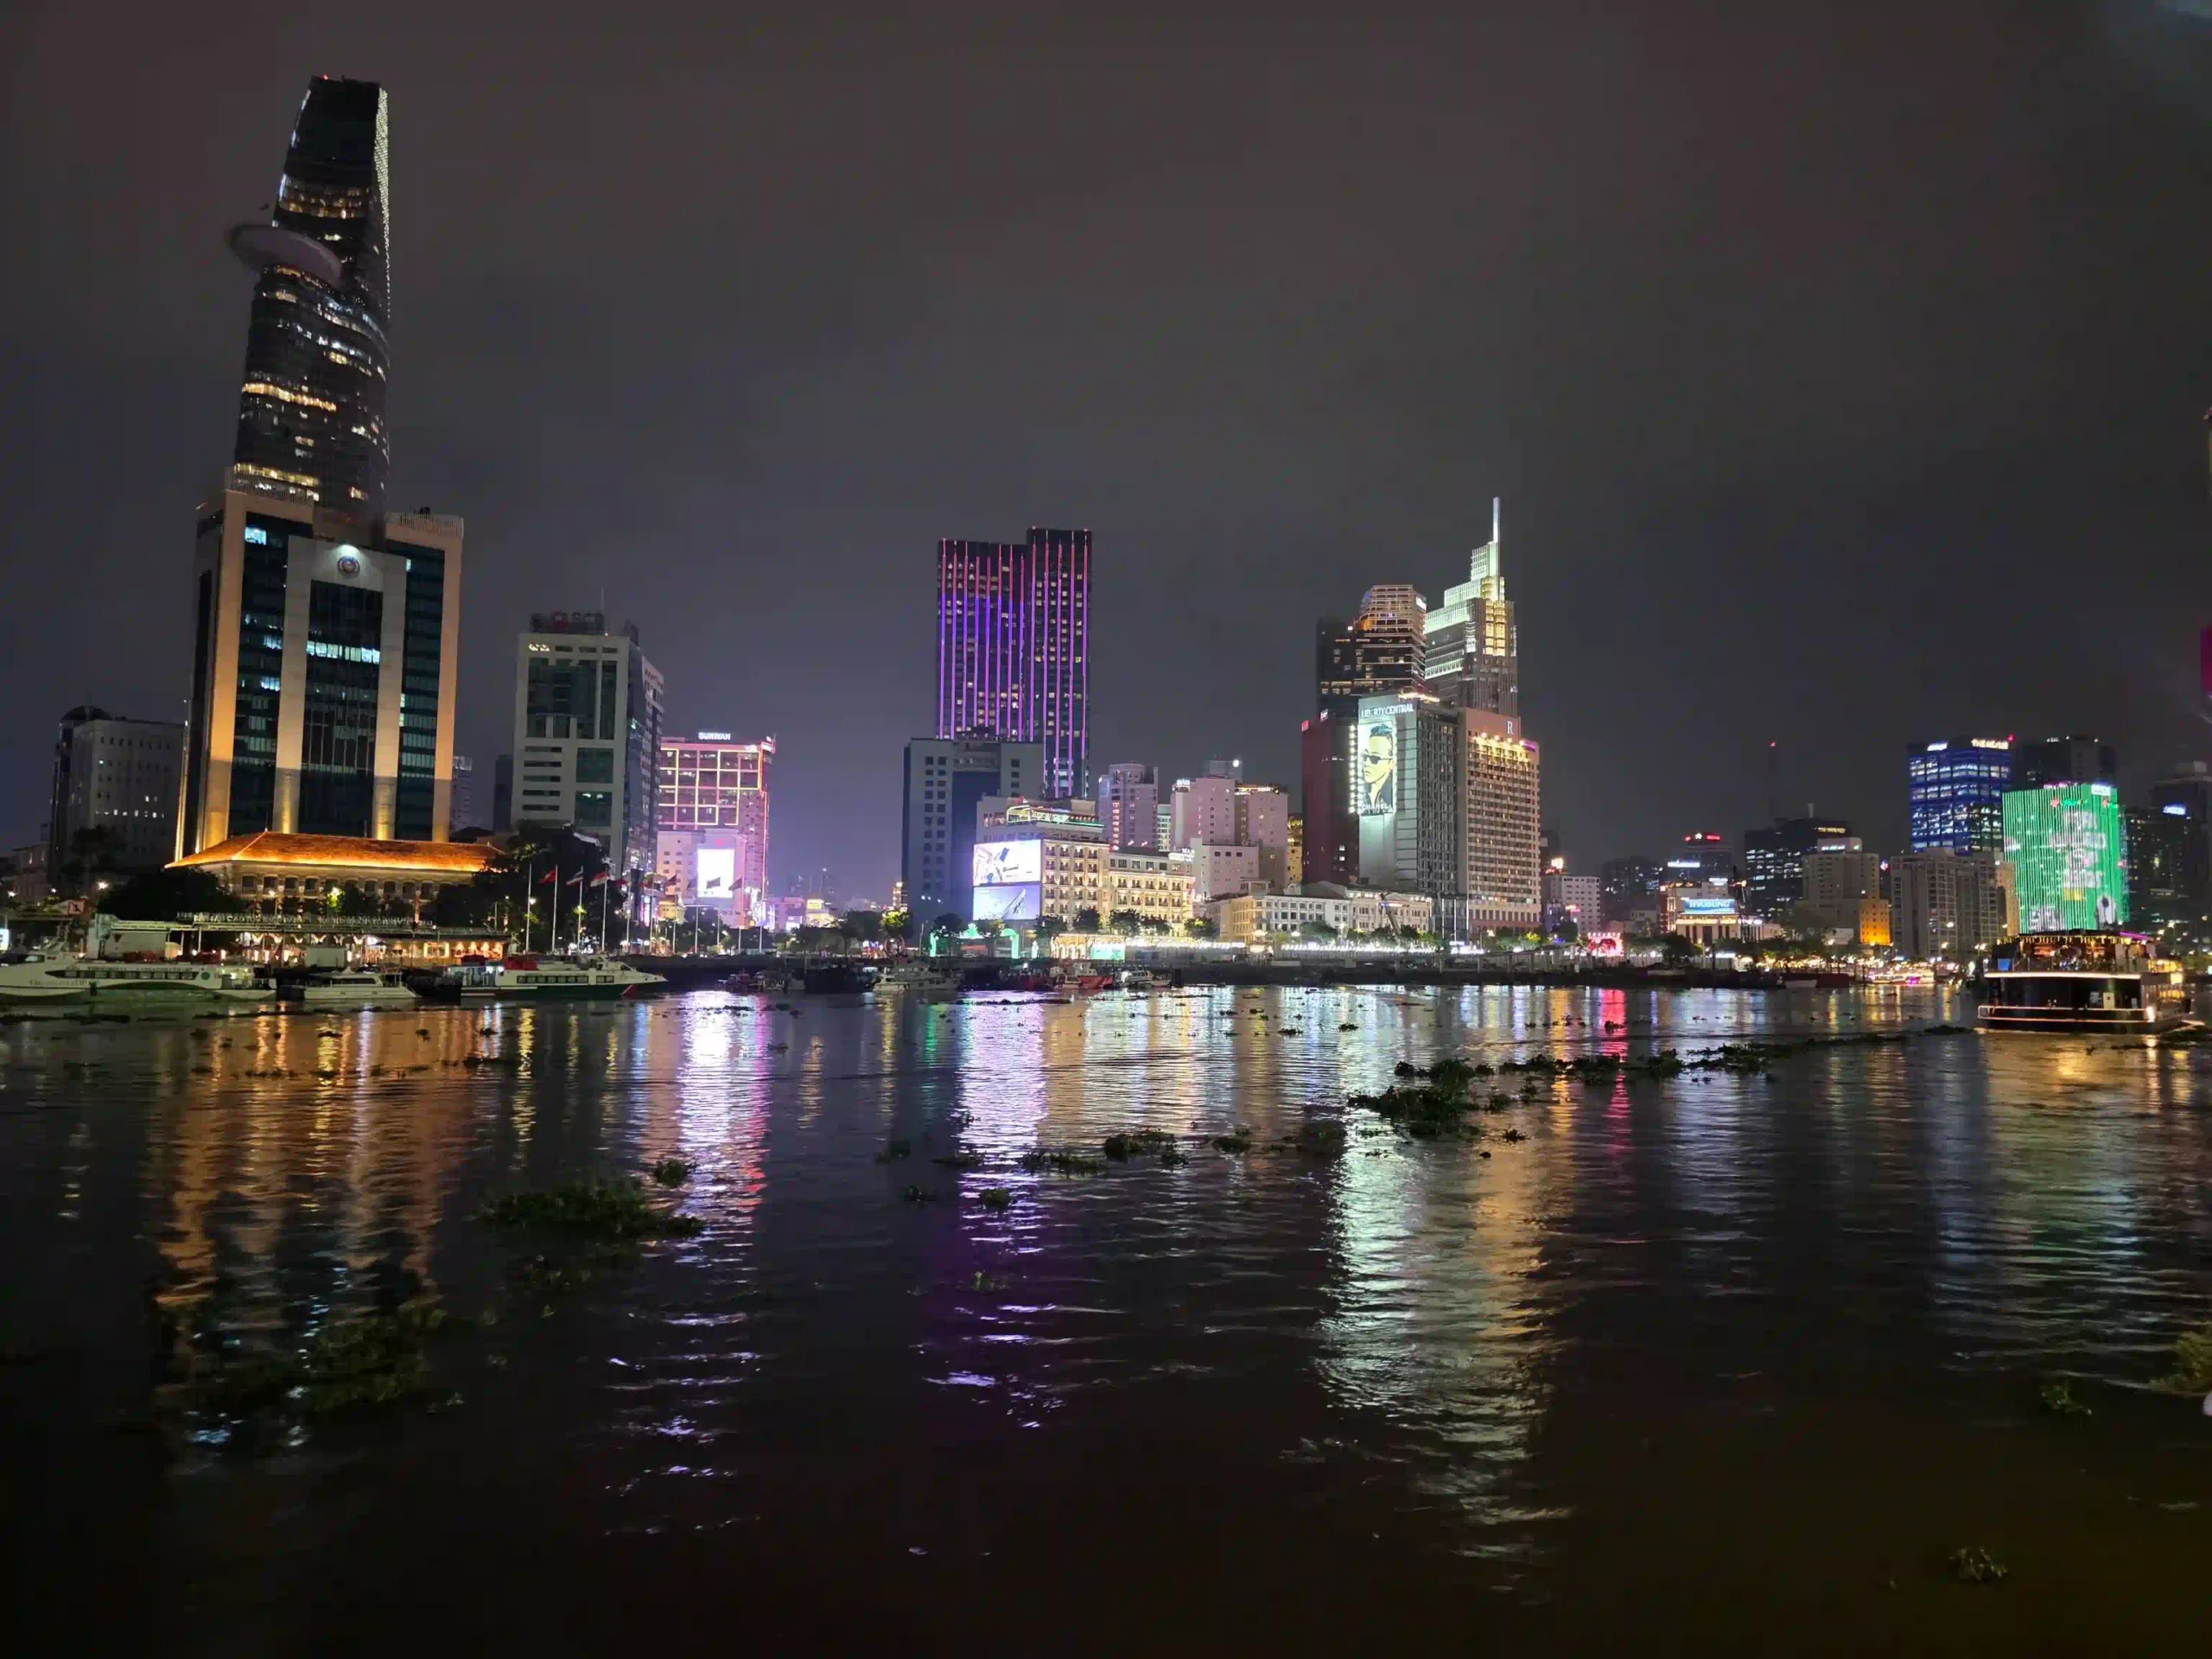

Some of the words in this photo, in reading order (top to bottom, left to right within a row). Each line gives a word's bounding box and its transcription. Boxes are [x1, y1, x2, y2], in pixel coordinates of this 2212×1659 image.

[1361, 707, 1385, 718] LIBERTY
[1385, 702, 1414, 715] CENTRAL
[1507, 721, 1515, 735] R
[1688, 899, 1730, 908] HYOSUNG
